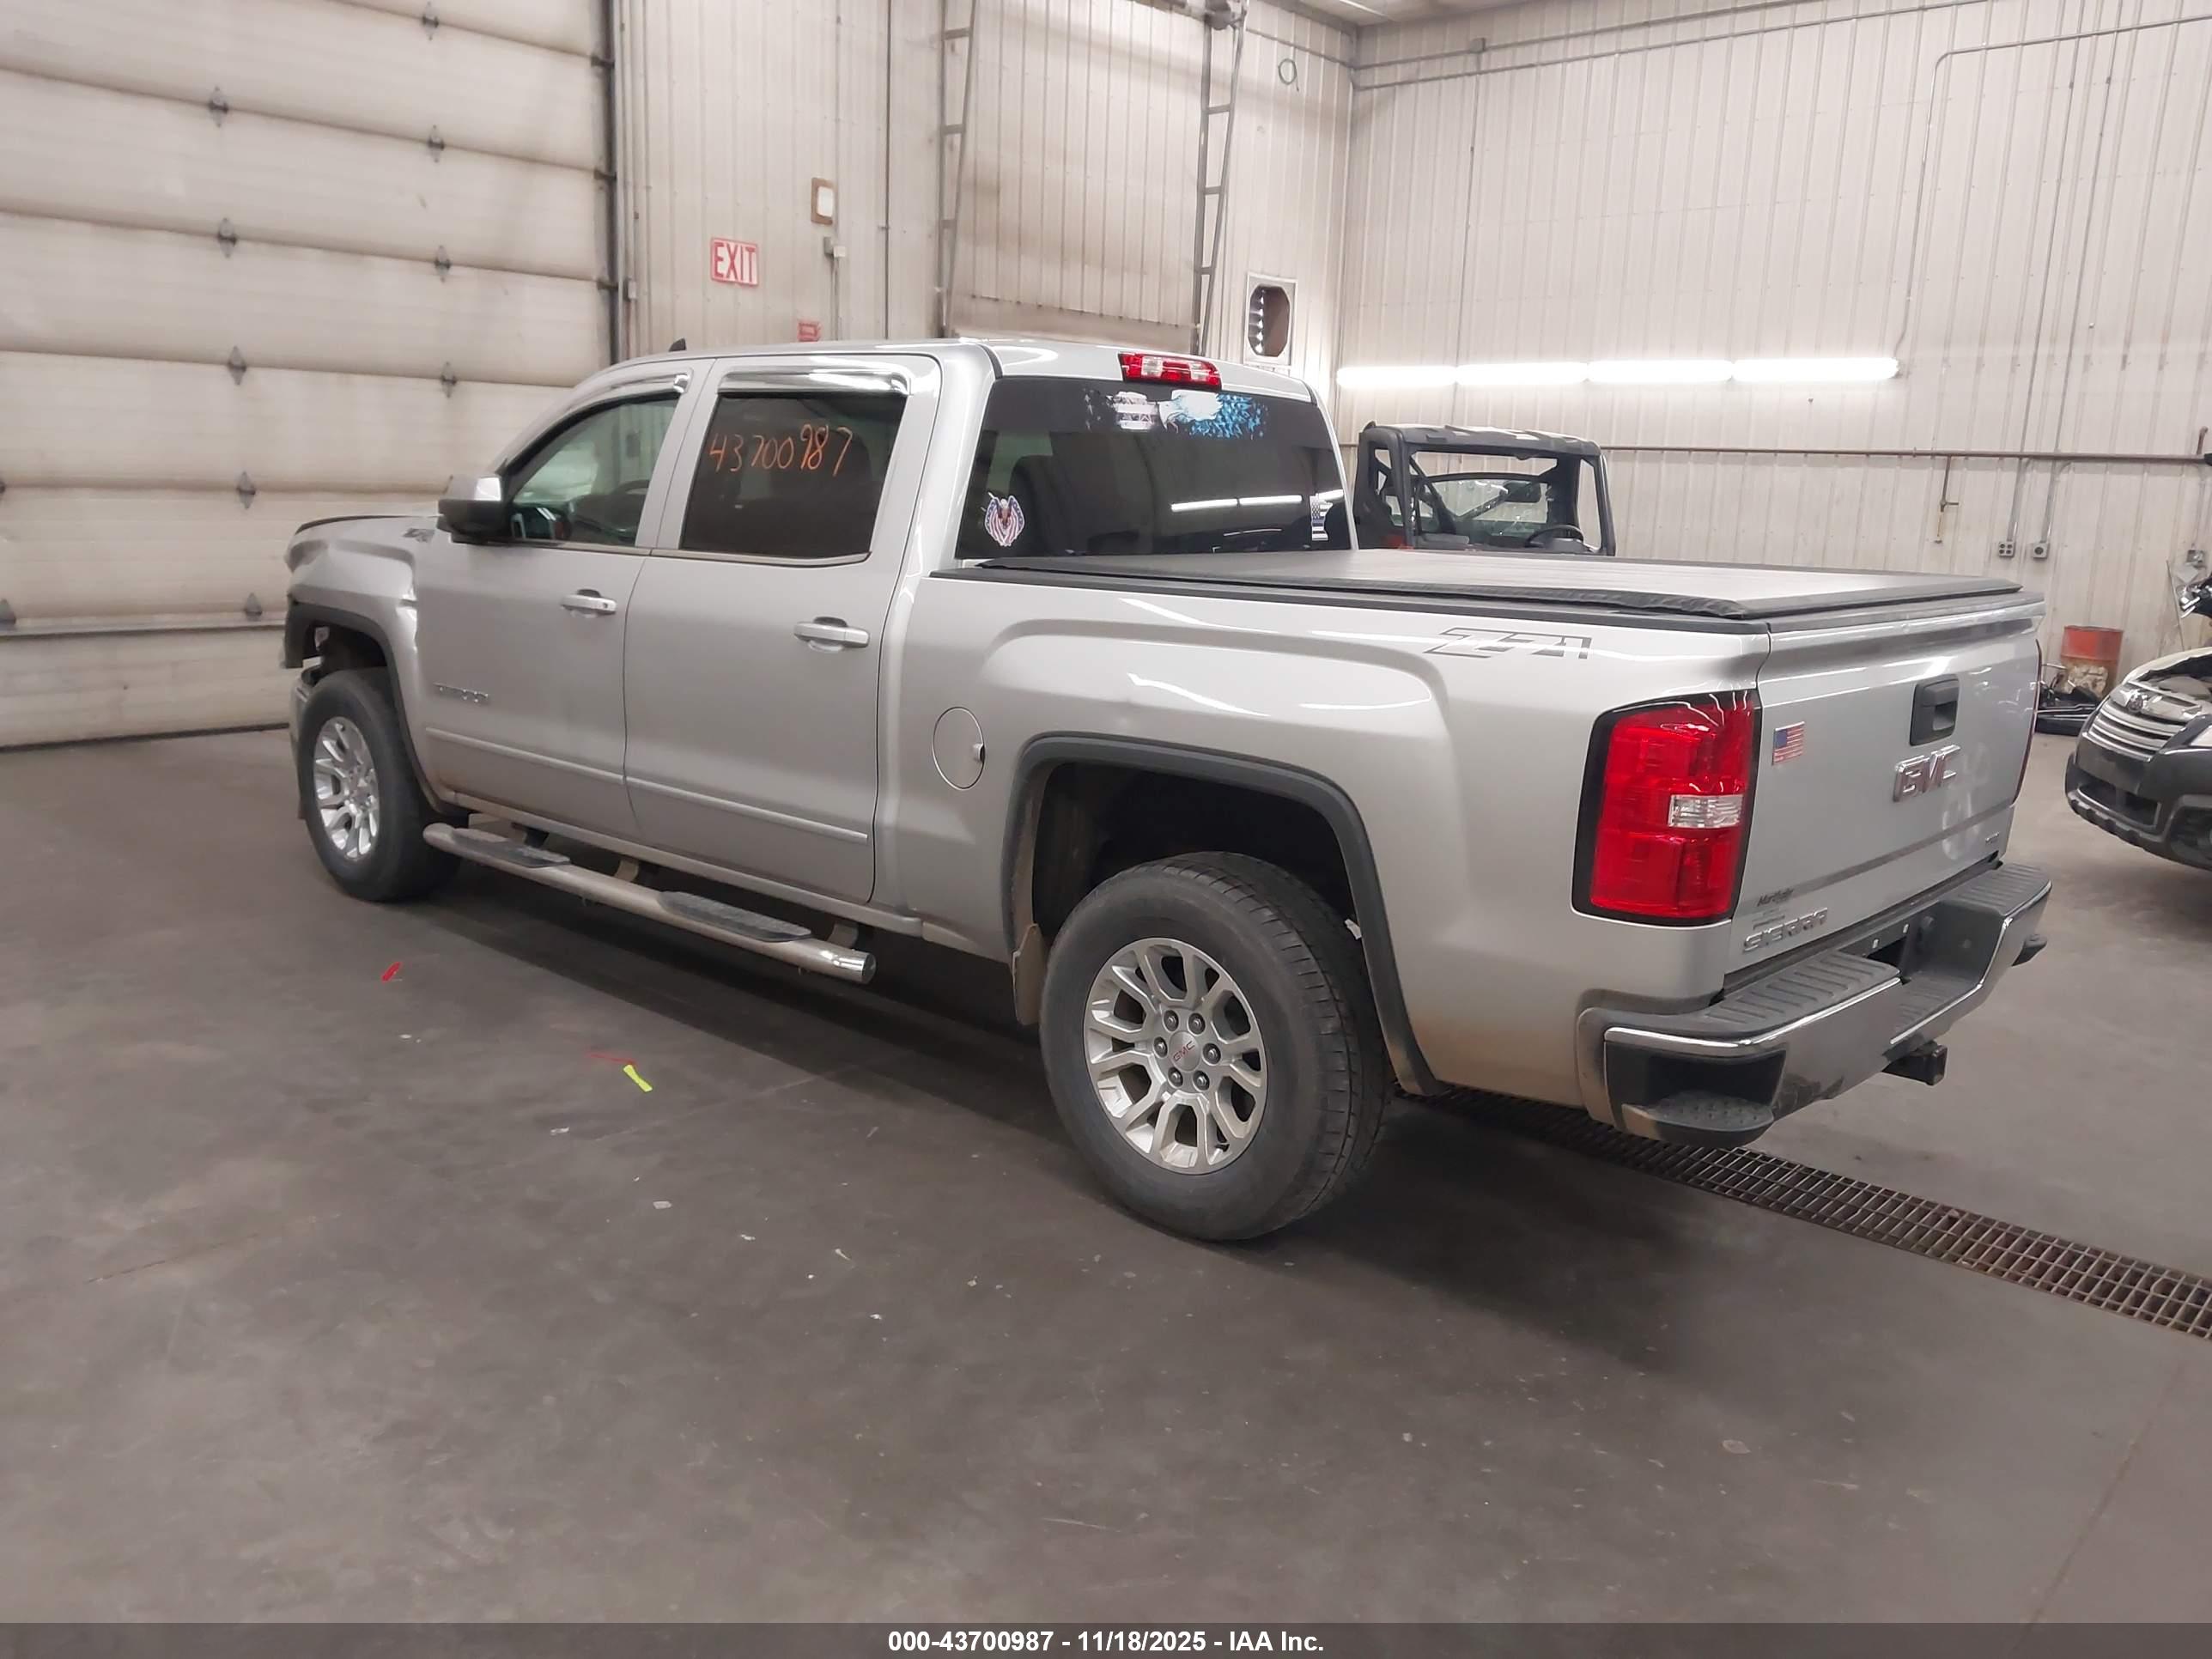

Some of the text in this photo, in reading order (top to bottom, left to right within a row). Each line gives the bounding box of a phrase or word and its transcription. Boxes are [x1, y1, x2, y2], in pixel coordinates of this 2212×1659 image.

[714, 241, 757, 283] EXIT
[709, 423, 853, 477] 43700987
[1893, 744, 1961, 803] GMC
[1743, 906, 1828, 954] SIERRA
[1173, 1040, 1195, 1062] GMC
